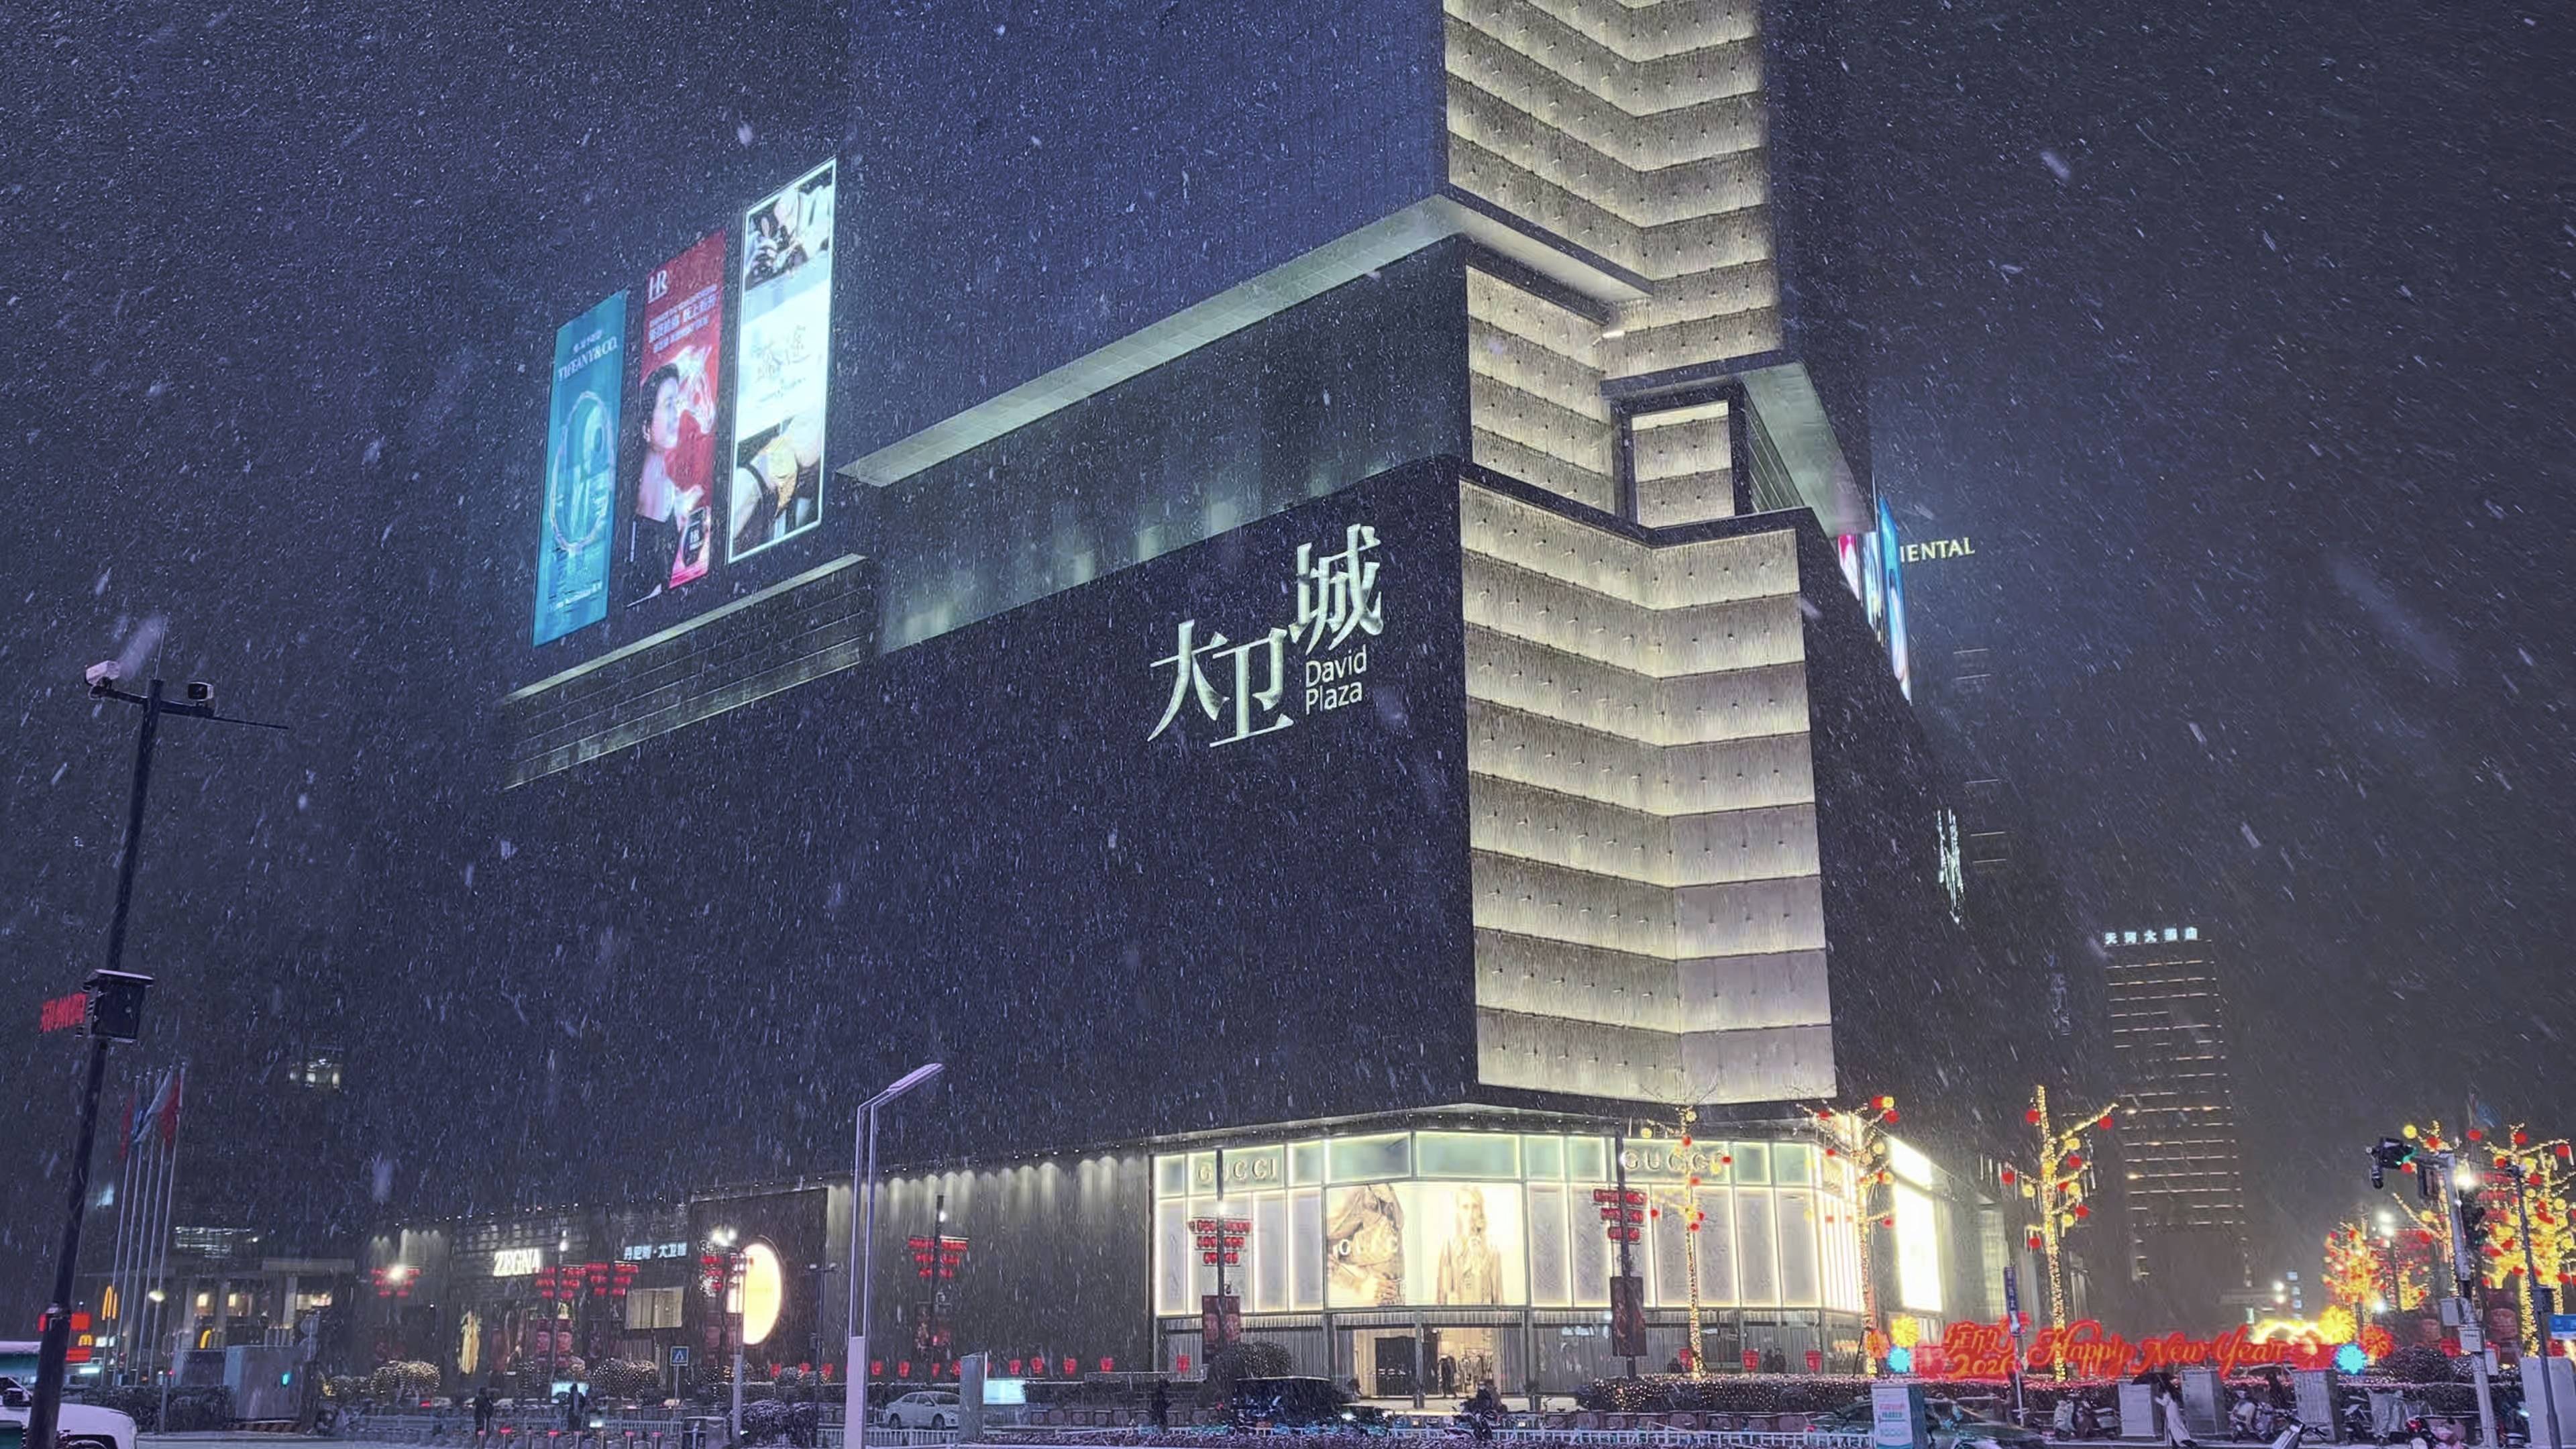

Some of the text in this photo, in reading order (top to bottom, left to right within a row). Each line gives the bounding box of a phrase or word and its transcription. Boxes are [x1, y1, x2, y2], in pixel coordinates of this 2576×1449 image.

[1148, 524, 1384, 747] 大卫城
[1306, 645, 1367, 688] David
[1306, 682, 1362, 715] Plaza
[1622, 1149, 1726, 1171] GUCC
[494, 1248, 540, 1277] ZEGNA
[2028, 1320, 2132, 1378] Happy
[2131, 1332, 2211, 1375] New
[2215, 1324, 2283, 1381] Year
